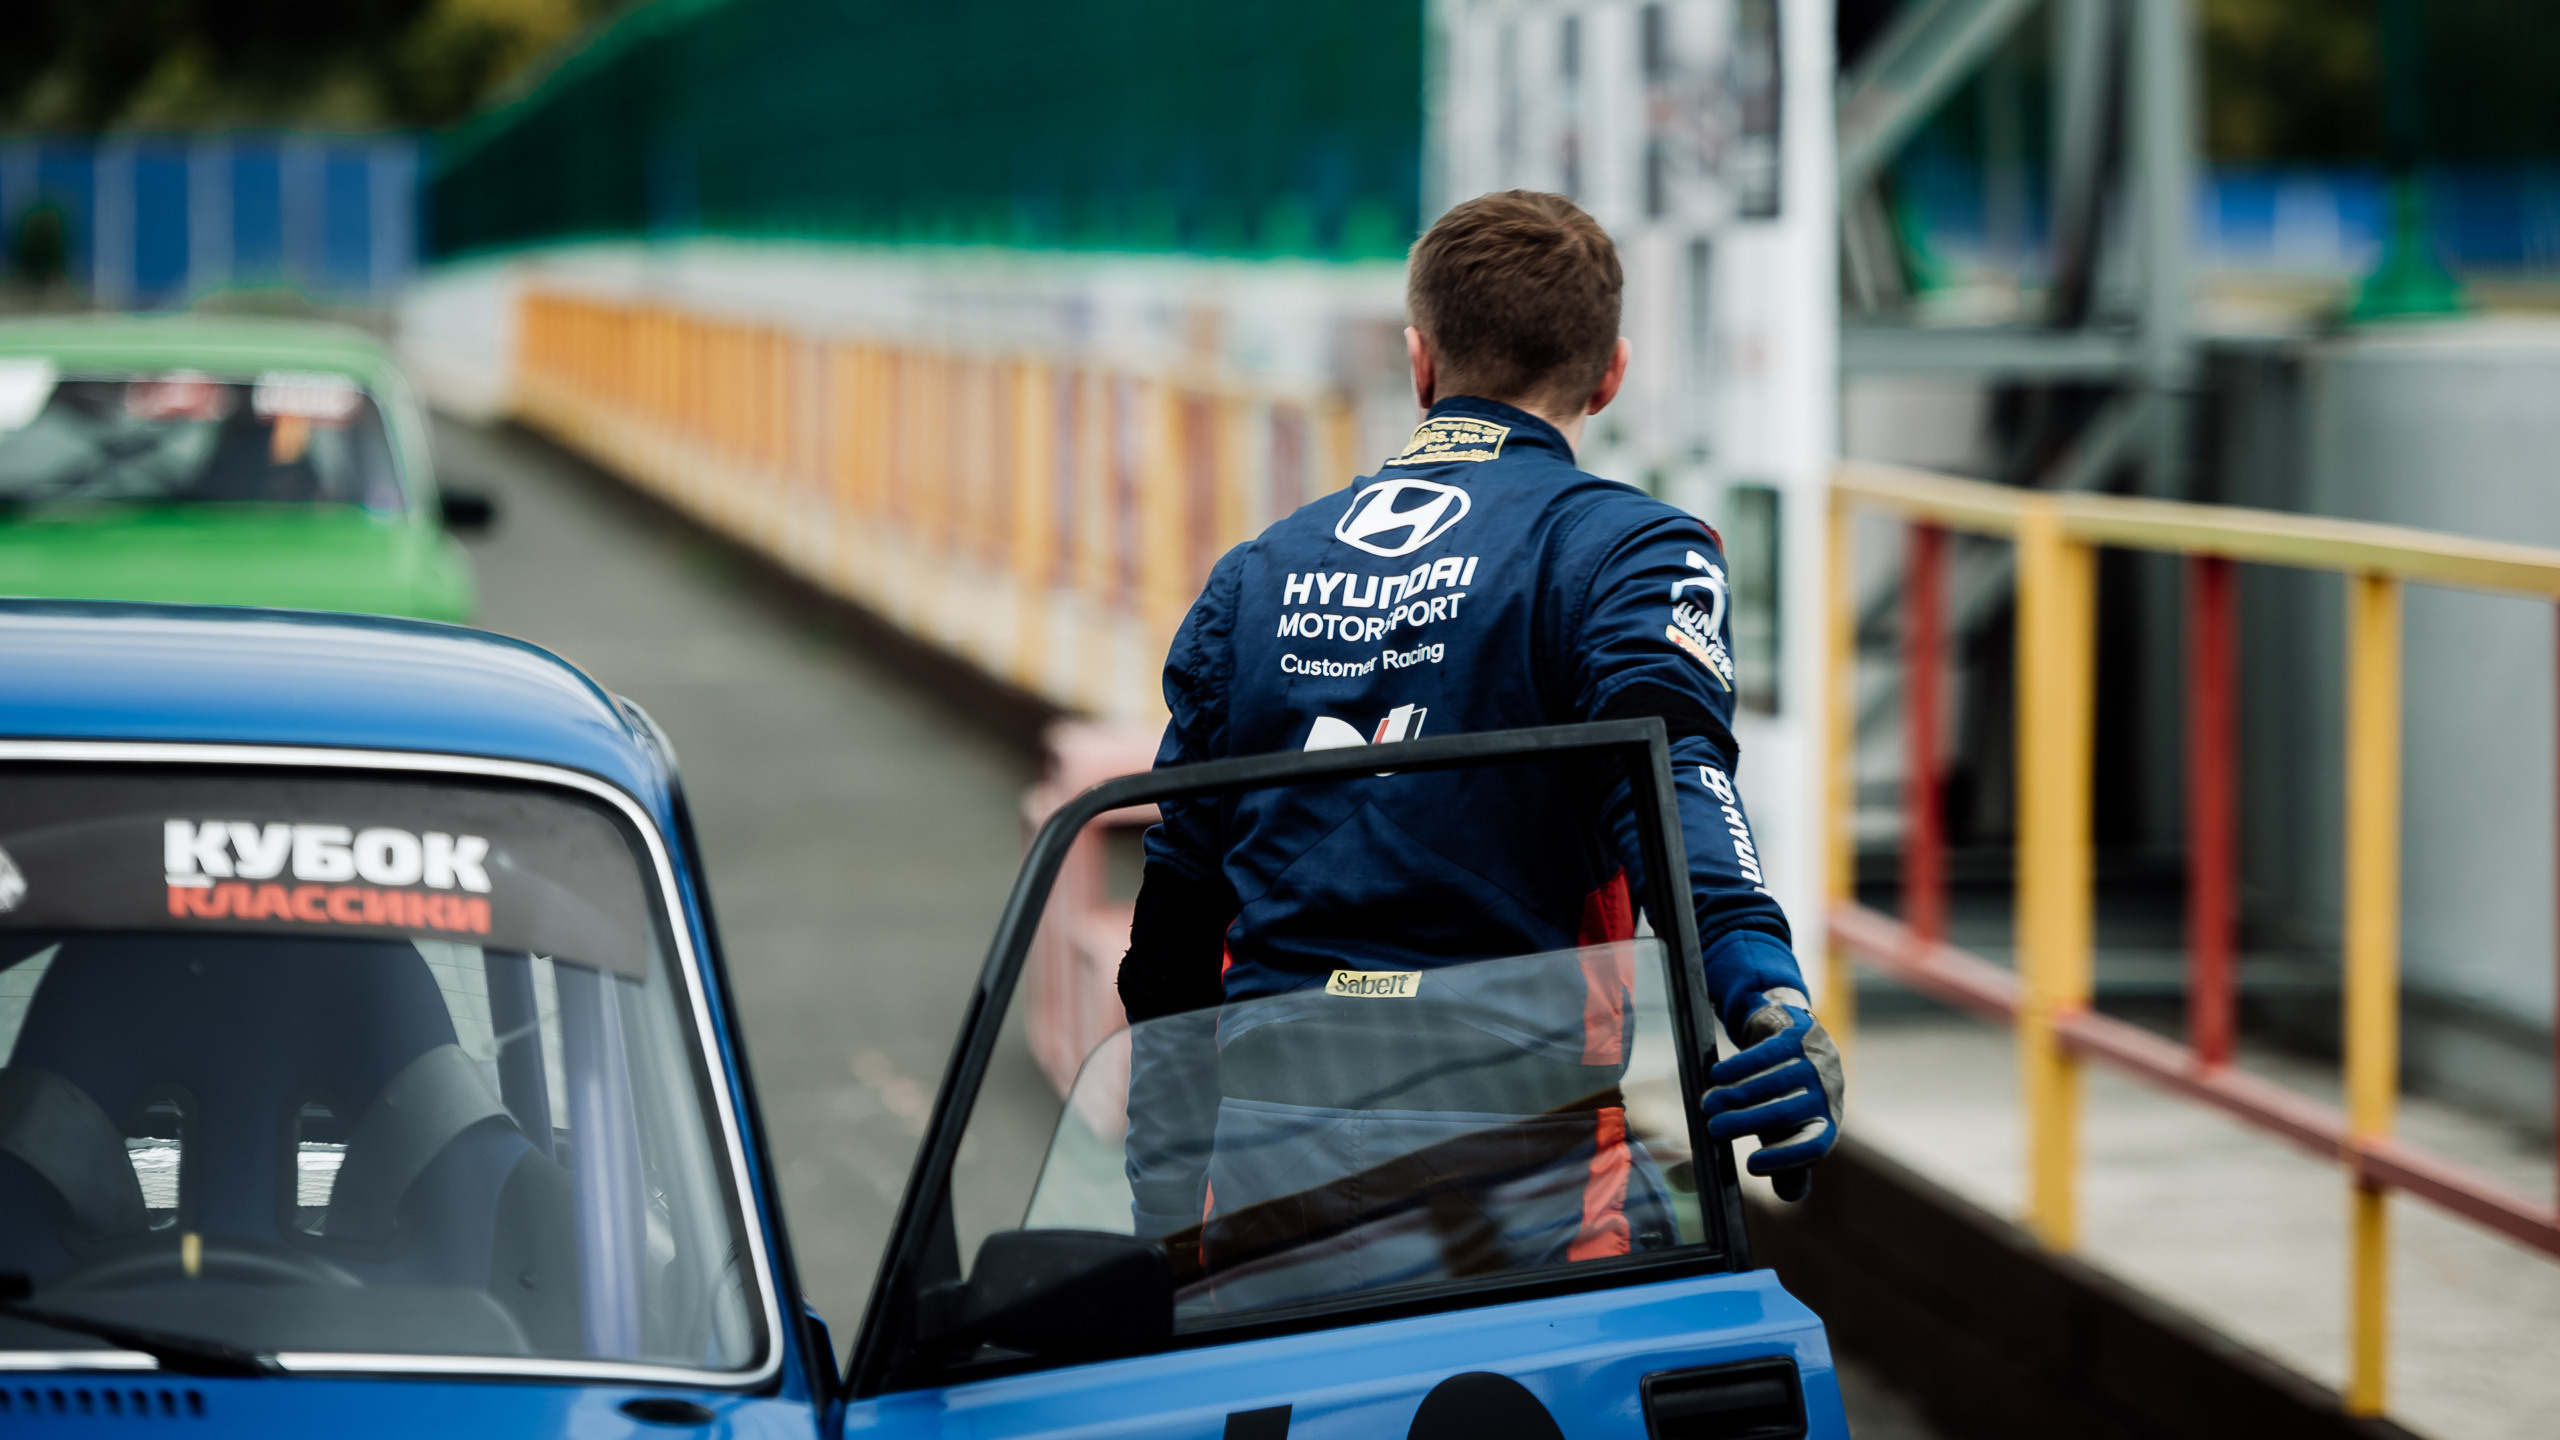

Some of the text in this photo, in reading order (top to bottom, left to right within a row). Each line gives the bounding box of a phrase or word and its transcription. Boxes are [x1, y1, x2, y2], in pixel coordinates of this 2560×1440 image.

[1283, 556, 1479, 609] HYUNDAI
[1277, 592, 1466, 642] MOTORSPORT
[1280, 643, 1445, 677] Customer Racing
[163, 818, 493, 894] КУБОК
[167, 882, 492, 936] КЛАССИКИ
[1335, 972, 1408, 995] Sabelt
